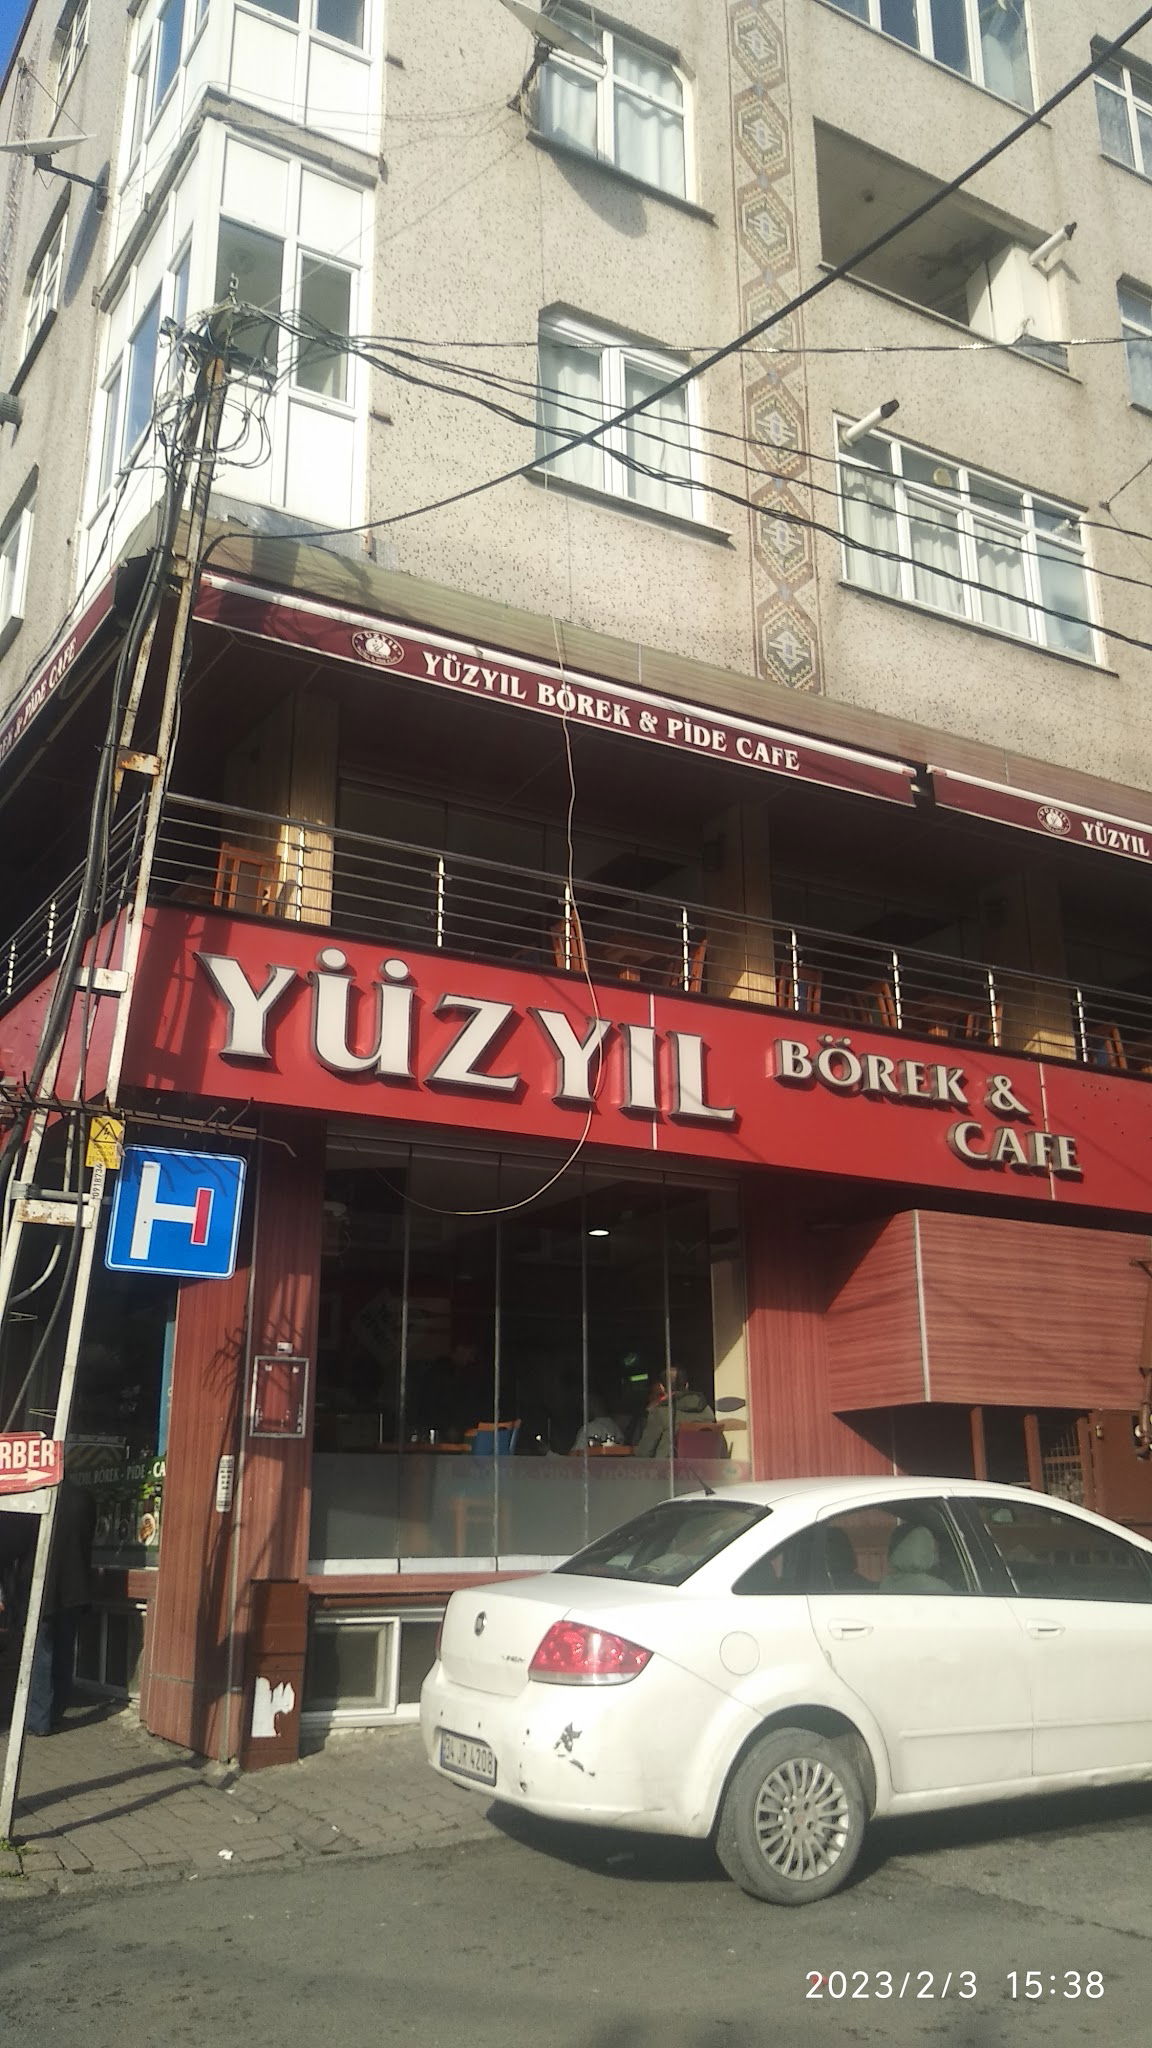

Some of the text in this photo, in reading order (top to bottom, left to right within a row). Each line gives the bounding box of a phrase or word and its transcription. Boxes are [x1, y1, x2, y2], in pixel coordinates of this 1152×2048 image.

[49, 637, 76, 689] CAFE
[422, 651, 527, 699] YÜZYIL
[537, 684, 631, 728] BÖREK
[639, 711, 658, 734] &
[667, 717, 728, 752] PİDE
[736, 737, 800, 771] CAFE
[1081, 821, 1150, 857] YÜZYIL
[192, 946, 736, 1121] YÜZYIL
[774, 1033, 1032, 1117] BÖREK &
[947, 1120, 1084, 1183] CAFE
